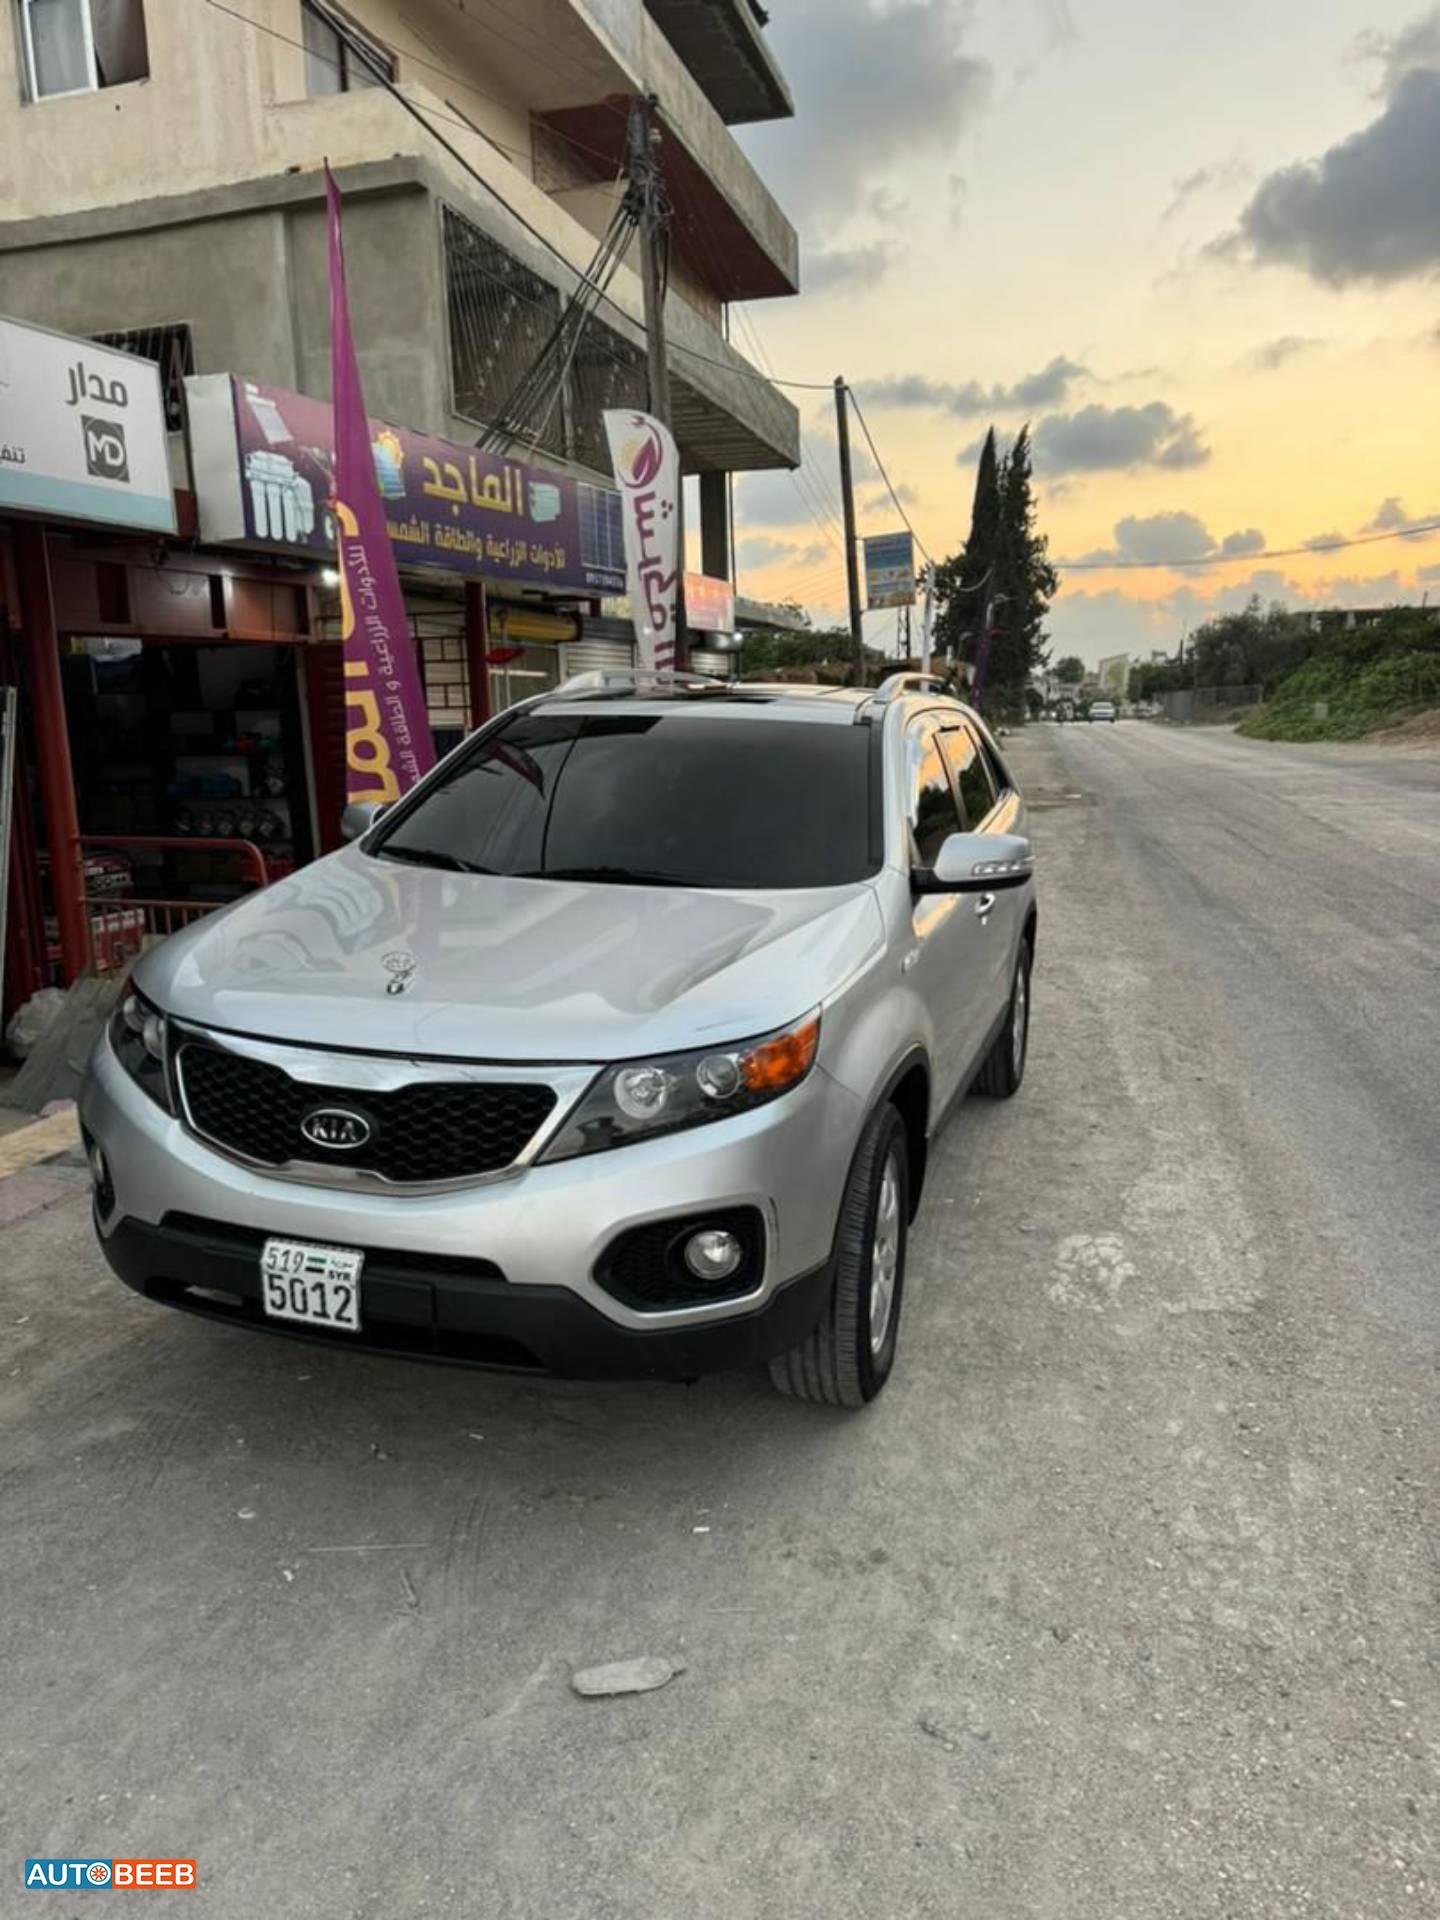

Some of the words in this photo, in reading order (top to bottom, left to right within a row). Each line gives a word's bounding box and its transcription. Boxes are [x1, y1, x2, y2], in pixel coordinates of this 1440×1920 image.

[65, 361, 129, 407] مدار
[0, 444, 26, 465] تنف
[88, 430, 125, 467] MD
[422, 455, 524, 516] الماجد
[385, 514, 430, 545] الشمس
[384, 695, 412, 745] الطاقة
[312, 1117, 357, 1142] KIA
[266, 1246, 305, 1274] 519
[268, 1273, 353, 1323] 5012
